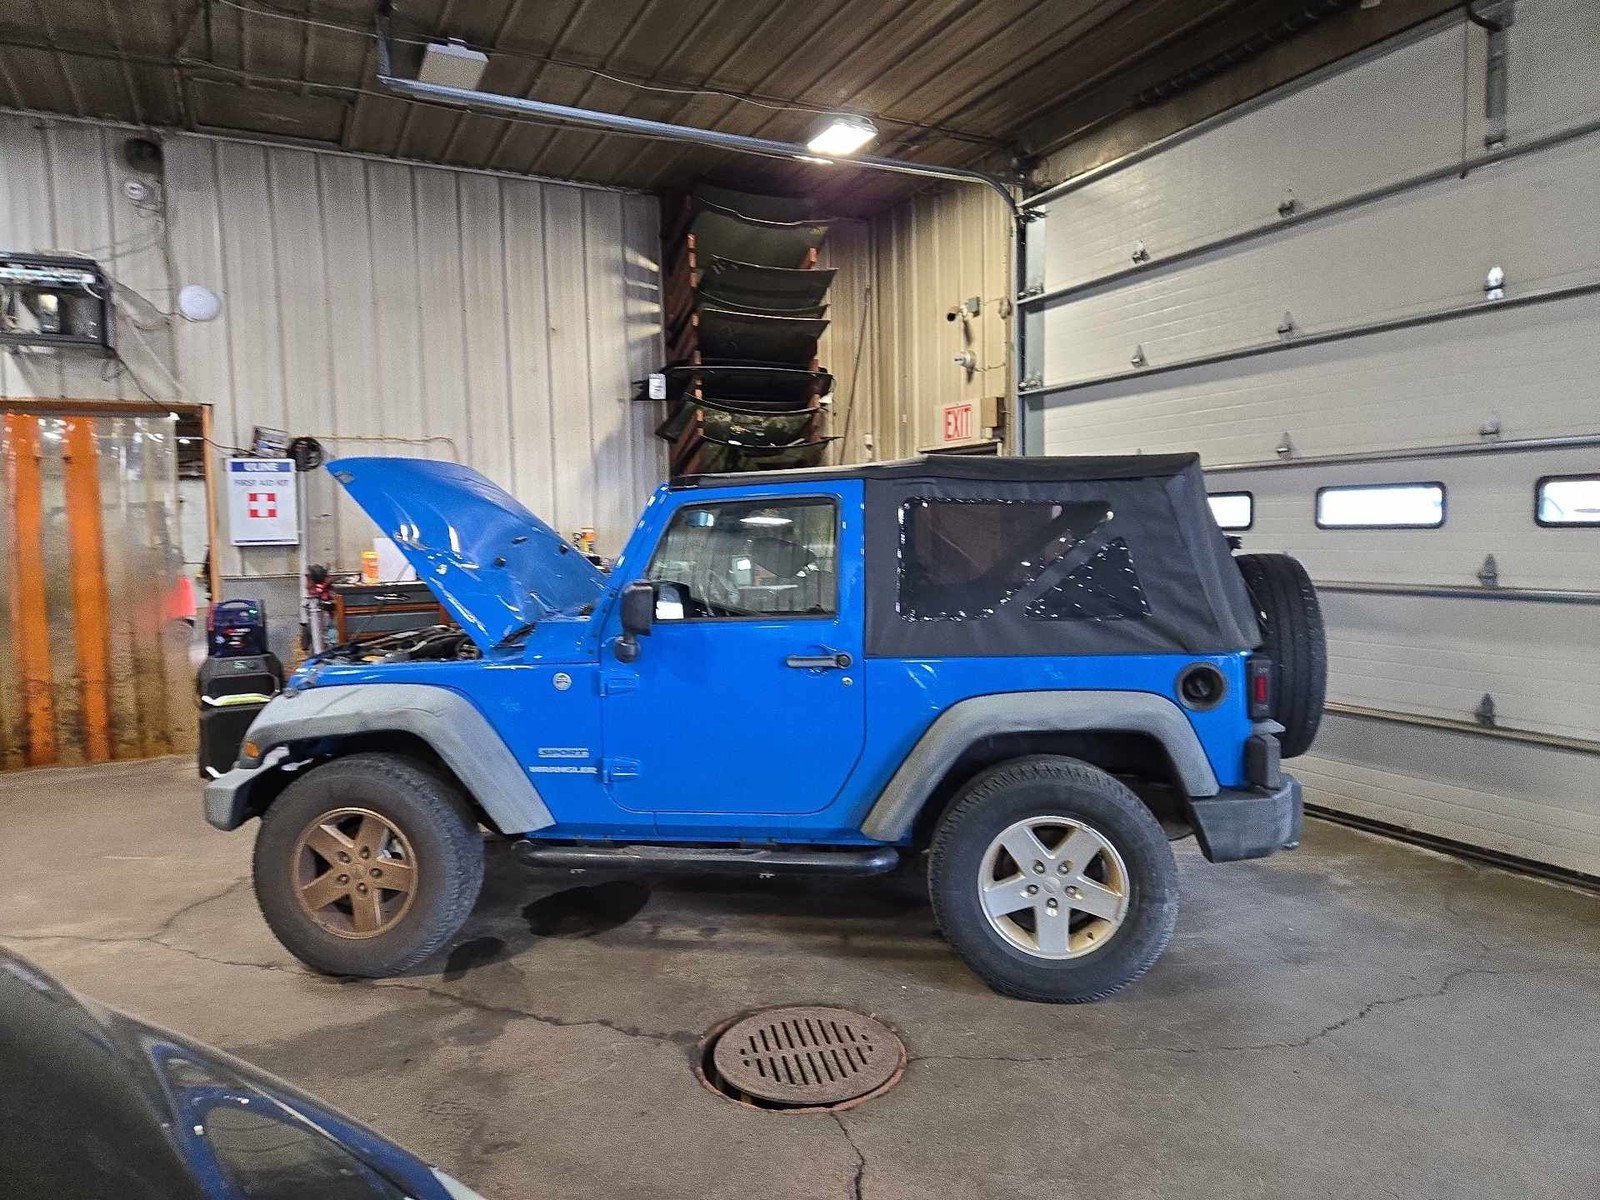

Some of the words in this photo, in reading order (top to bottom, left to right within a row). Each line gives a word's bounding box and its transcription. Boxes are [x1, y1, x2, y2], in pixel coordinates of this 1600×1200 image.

[944, 408, 972, 439] EXIT
[243, 462, 279, 472] ULINE
[539, 748, 589, 757] SPORT
